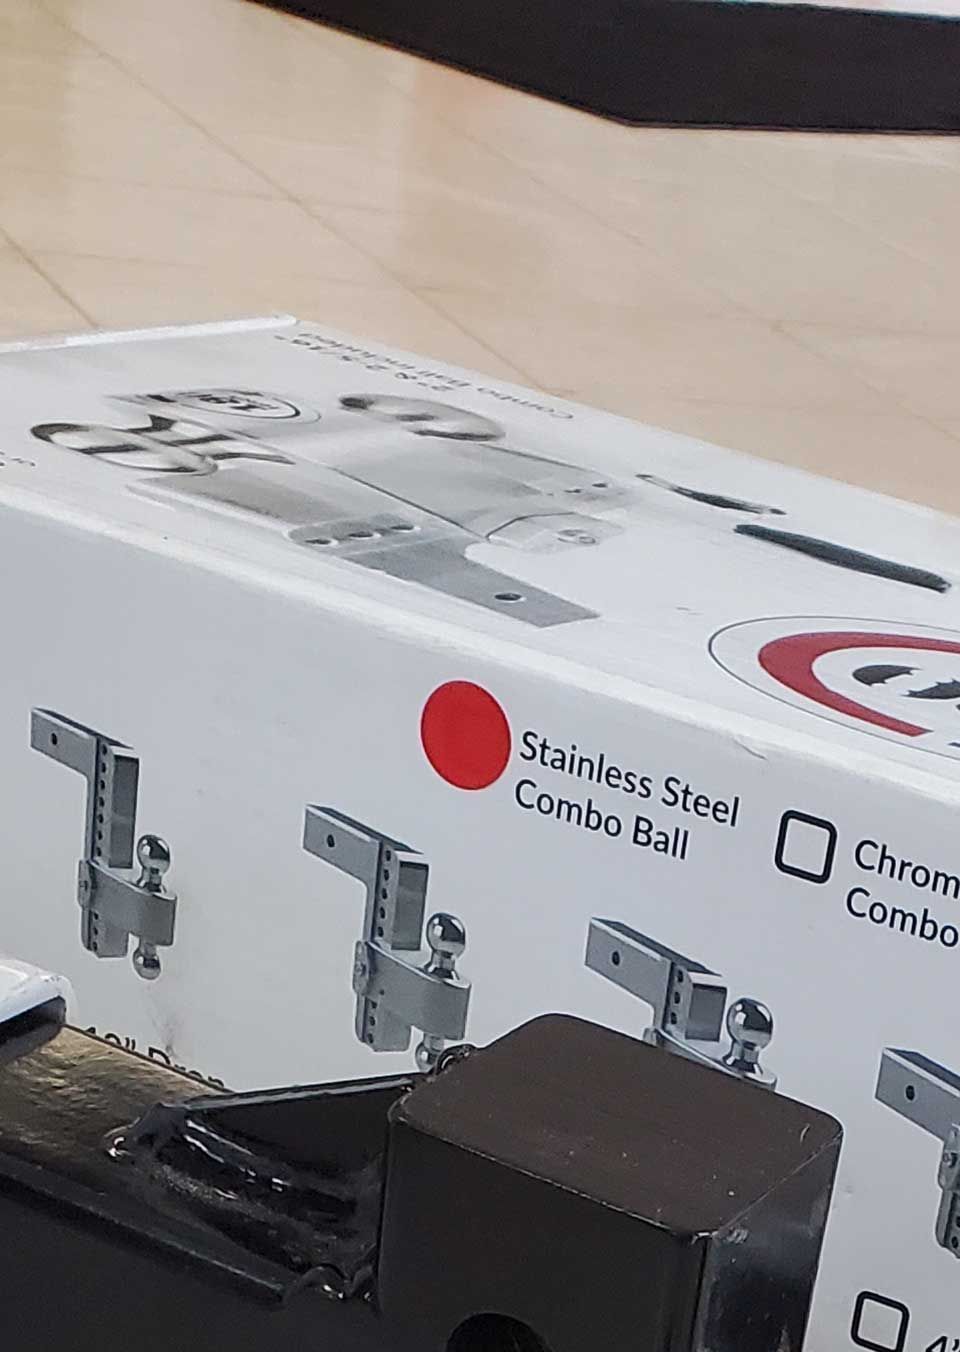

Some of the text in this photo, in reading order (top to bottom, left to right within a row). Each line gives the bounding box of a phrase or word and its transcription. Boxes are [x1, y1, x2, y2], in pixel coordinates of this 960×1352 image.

[477, 388, 573, 420] Combo
[519, 730, 740, 827] Stainless Steel
[513, 778, 692, 860] Combo Ball
[845, 886, 960, 947] Combo
